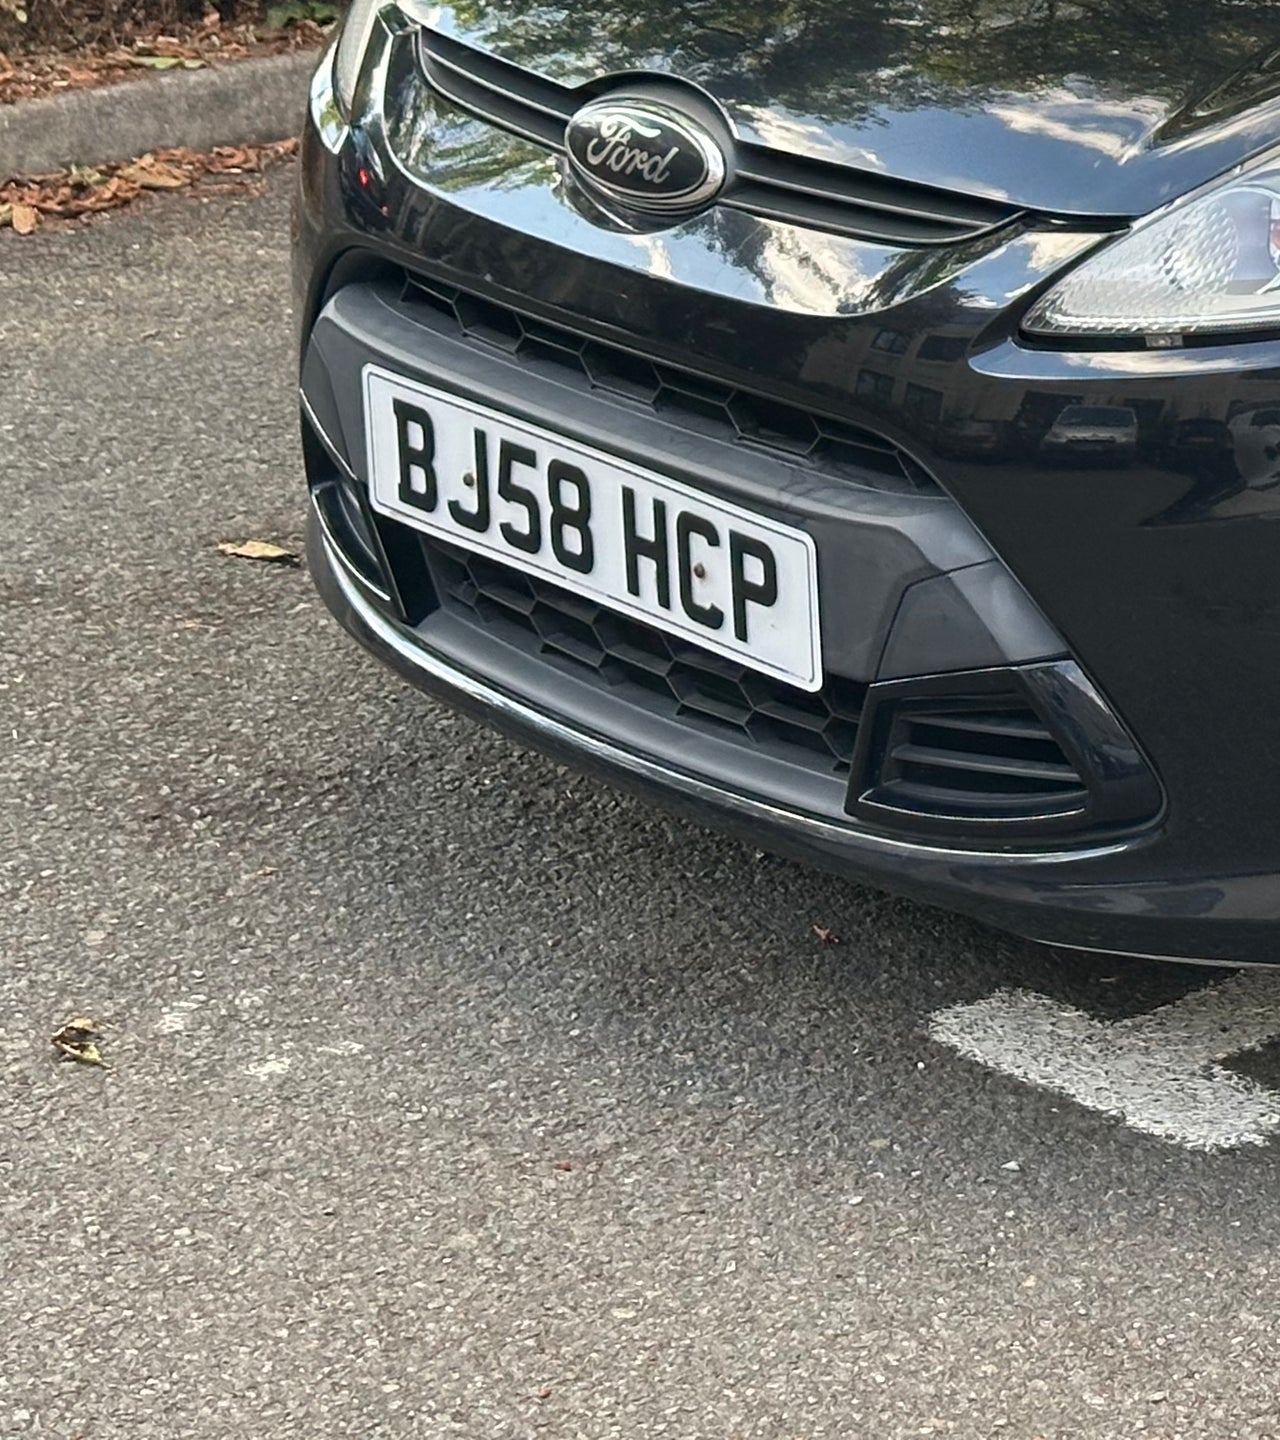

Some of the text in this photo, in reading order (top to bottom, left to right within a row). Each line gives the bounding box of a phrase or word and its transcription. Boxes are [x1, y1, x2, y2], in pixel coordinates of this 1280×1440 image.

[586, 114, 679, 184] Ford
[392, 397, 778, 643] BJ58 HCP
